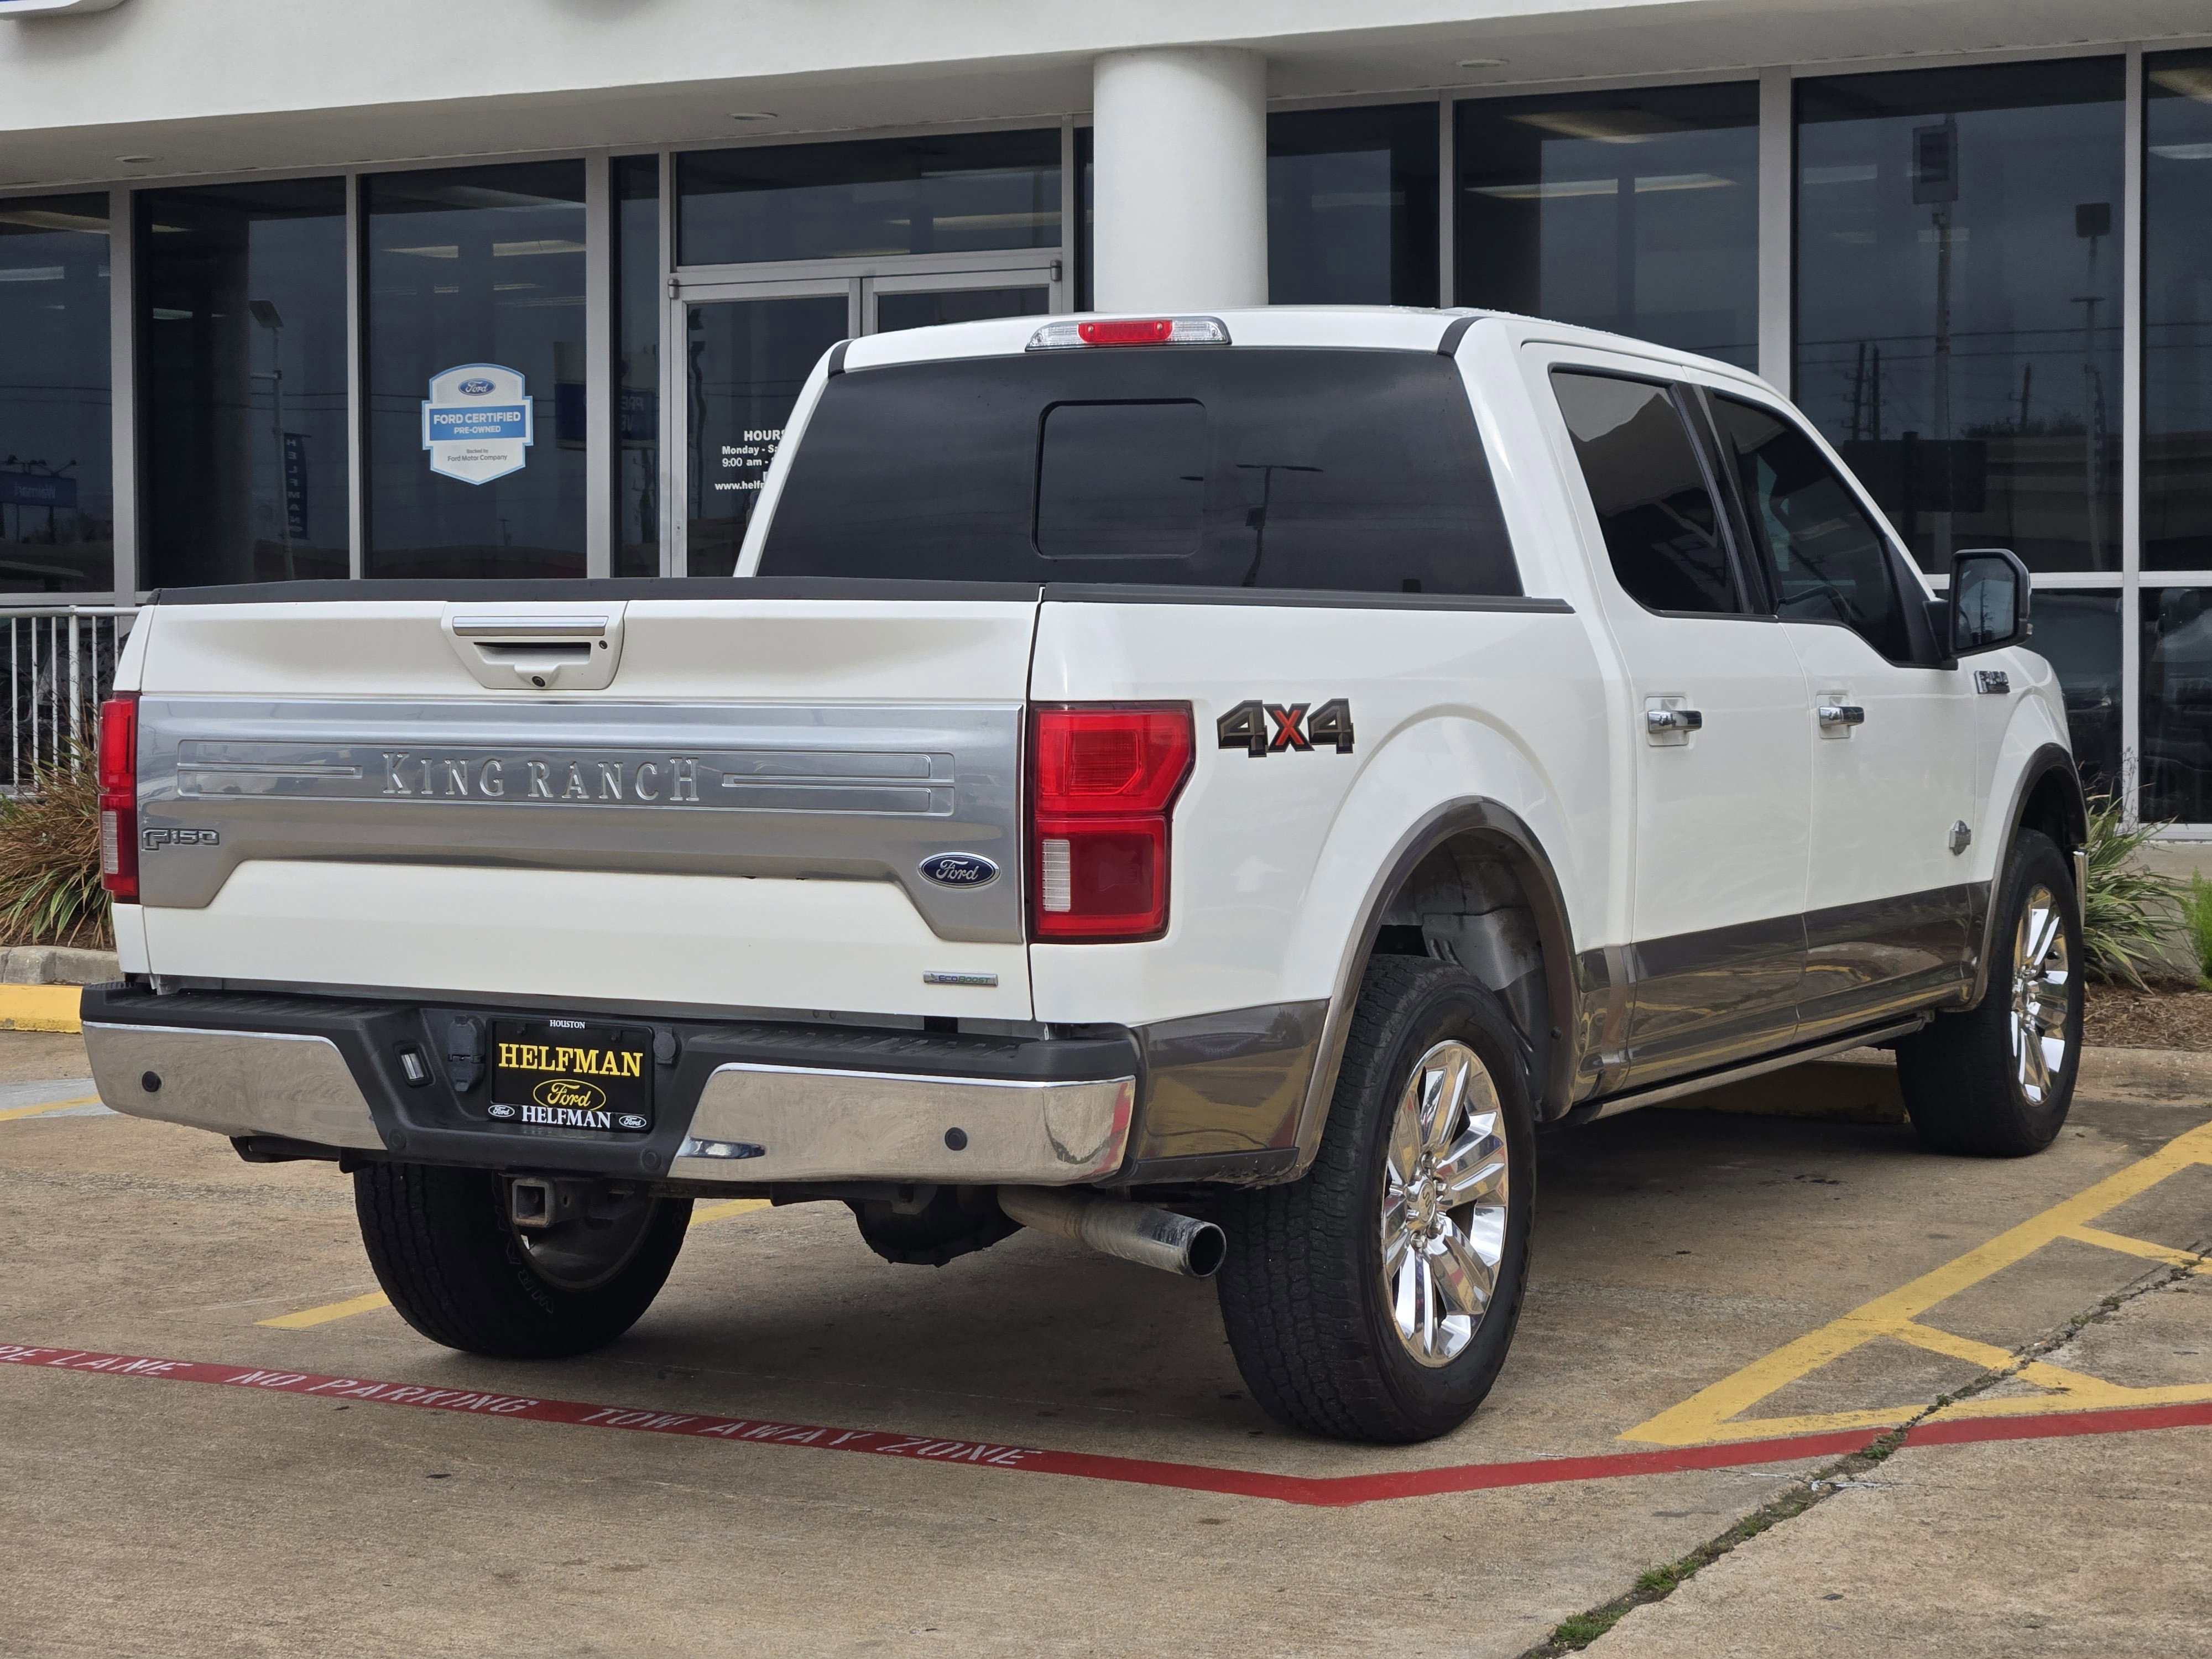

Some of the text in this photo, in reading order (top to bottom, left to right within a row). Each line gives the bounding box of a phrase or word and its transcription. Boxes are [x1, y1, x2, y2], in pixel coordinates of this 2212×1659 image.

[465, 382, 488, 393] Ford
[434, 411, 521, 425] FORD CERTIFIED
[454, 425, 501, 434] PRE-OWNED
[722, 445, 759, 456] Monday
[722, 457, 743, 467] 9:00
[383, 751, 700, 801] KING RANCH
[936, 859, 979, 880] Ford
[549, 1020, 586, 1029] HOUSTON
[498, 1043, 643, 1077] HELFMAN
[547, 1082, 592, 1107] Ford
[521, 1105, 612, 1129] HELFMAN
[46, 1352, 194, 1375] LANE
[223, 1370, 307, 1387] NO
[305, 1379, 539, 1413] PARKING
[579, 1408, 699, 1429] TOW
[697, 1421, 875, 1446] AWAY
[875, 1437, 1044, 1465] ZONE
